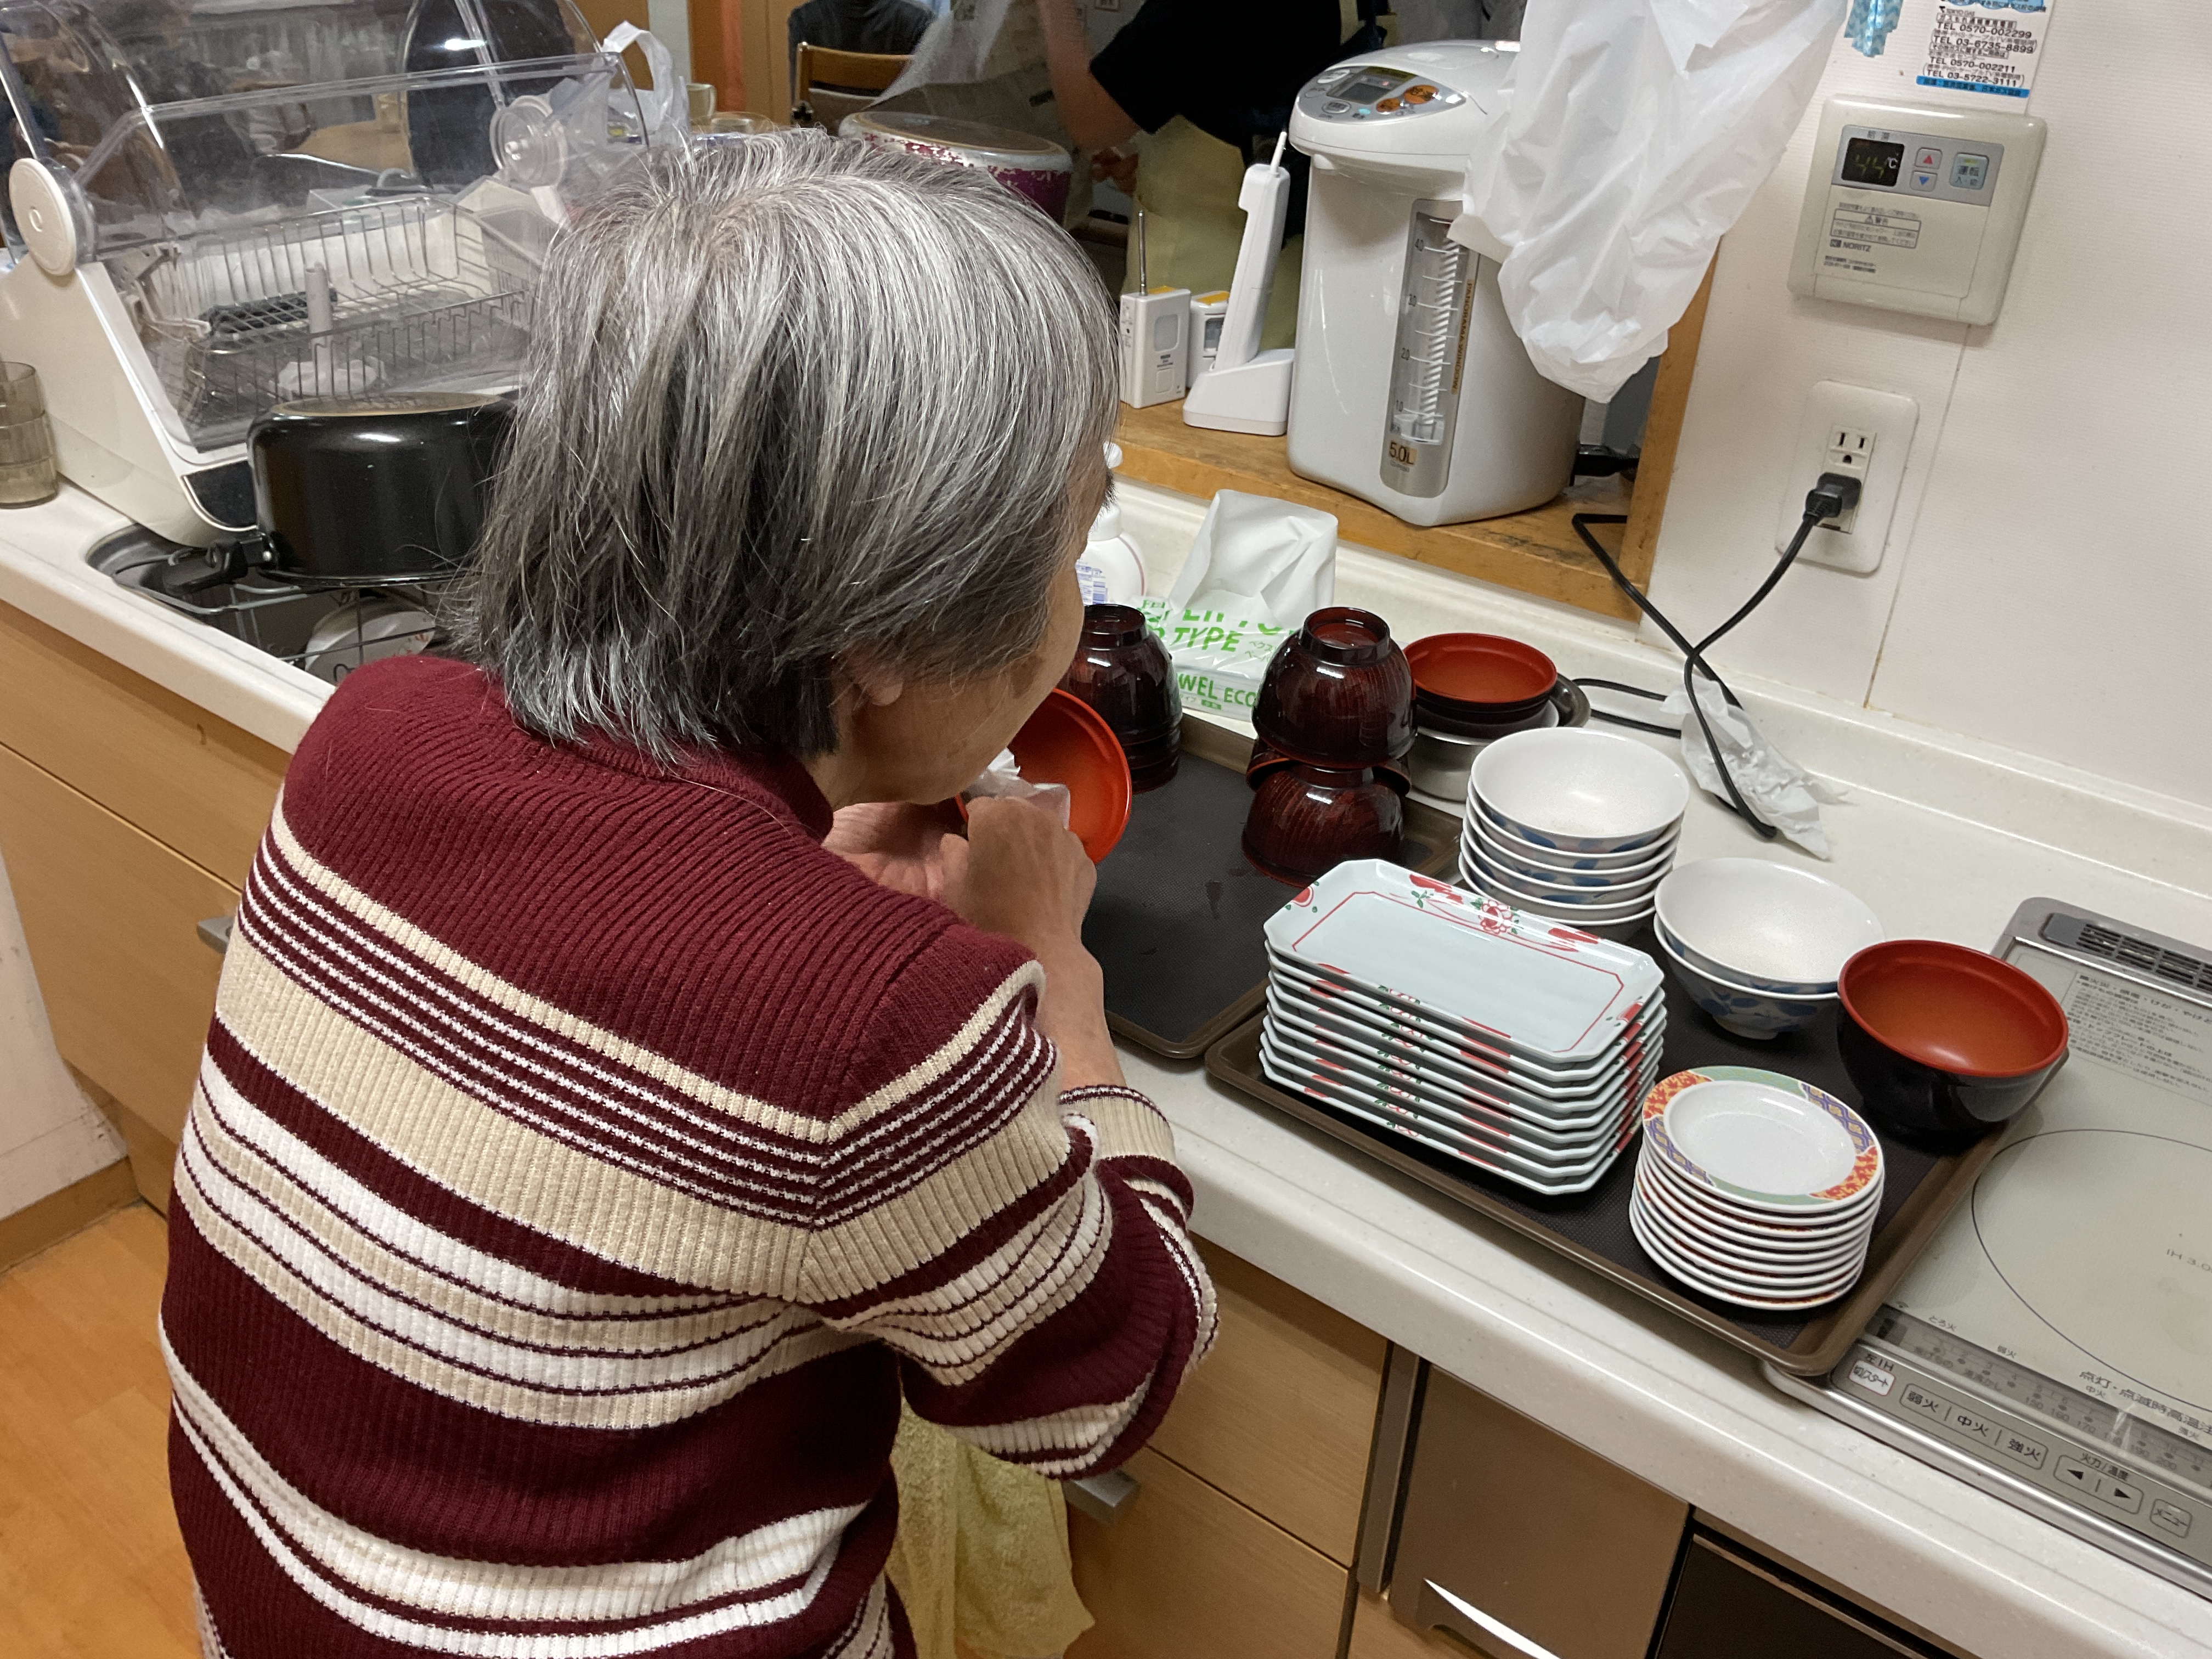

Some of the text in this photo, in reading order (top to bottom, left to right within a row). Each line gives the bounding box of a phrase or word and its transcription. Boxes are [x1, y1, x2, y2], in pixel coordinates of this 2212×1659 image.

[1938, 21, 2032, 39] TEL 0570-002299
[1934, 35, 2034, 54] TEL 03-6735-8899
[1930, 56, 2016, 73] TEL 0570-002211
[1927, 69, 2017, 87] TEL 03-5722-3111
[1170, 627, 1243, 652] TYPE
[1176, 673, 1217, 700] WEL
[1223, 687, 1257, 708] ECO
[2166, 1249, 2212, 1273] IH 3.0
[1928, 1315, 1956, 1331] とろ火
[1865, 1352, 1895, 1372] 左IH
[2086, 1385, 2106, 1399] 中火
[1906, 1390, 2041, 1462] 弱火 中火 強火
